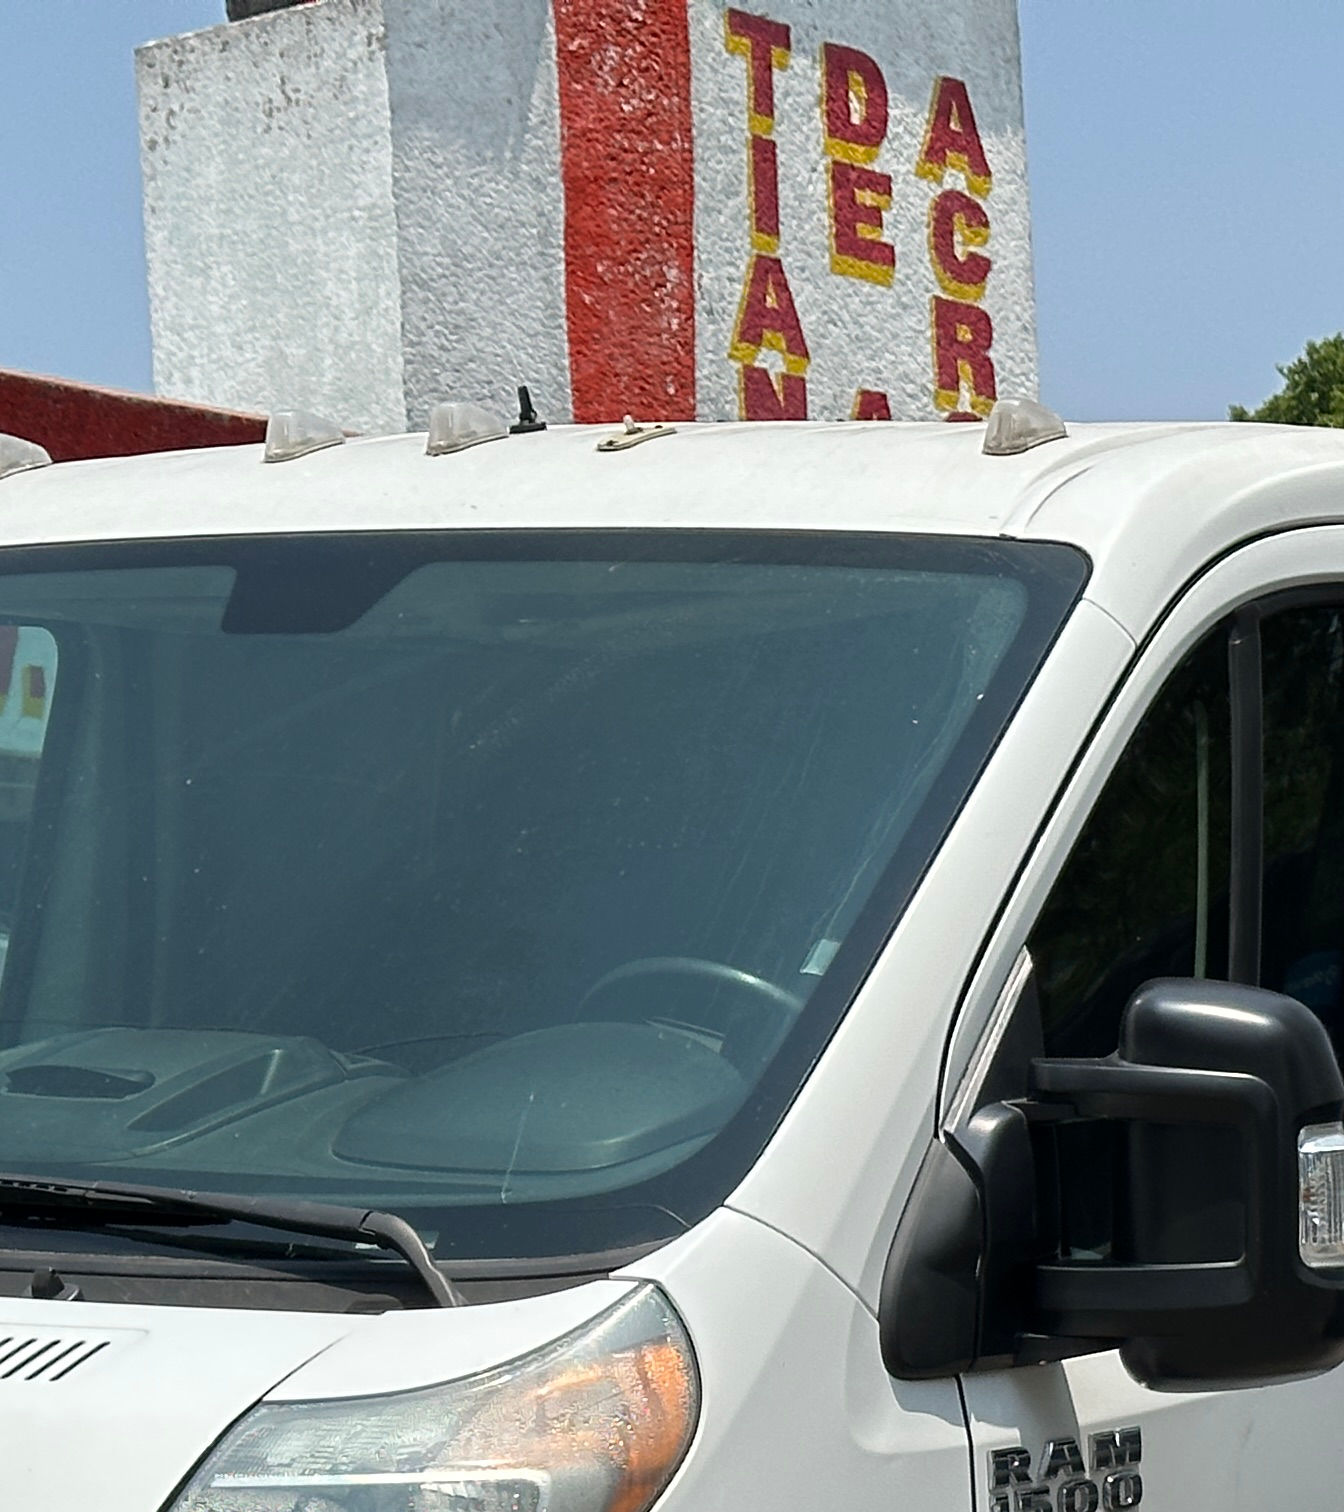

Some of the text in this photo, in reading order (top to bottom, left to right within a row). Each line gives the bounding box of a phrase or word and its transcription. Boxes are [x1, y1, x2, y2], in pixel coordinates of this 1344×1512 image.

[821, 41, 896, 287] DE
[915, 76, 997, 420] ACR
[987, 1425, 1143, 1494] RAM
